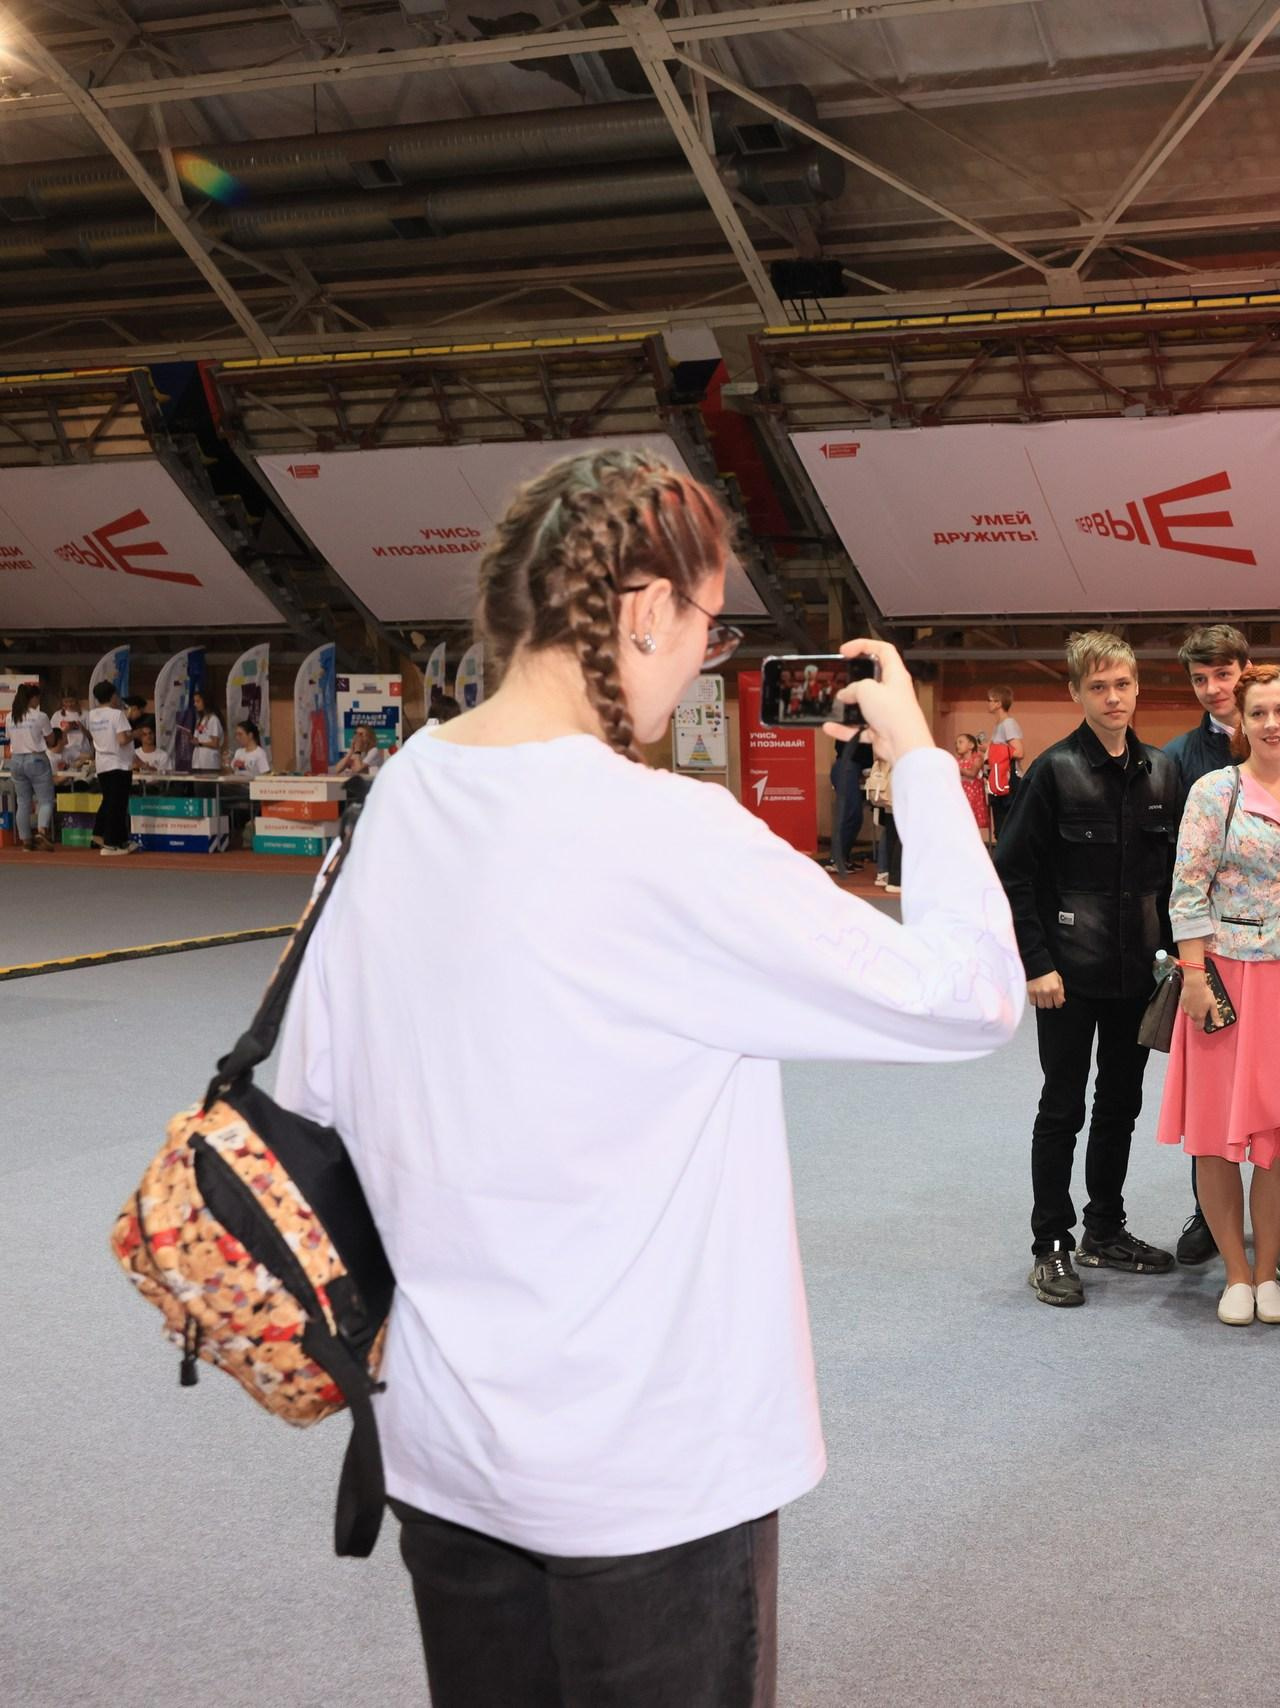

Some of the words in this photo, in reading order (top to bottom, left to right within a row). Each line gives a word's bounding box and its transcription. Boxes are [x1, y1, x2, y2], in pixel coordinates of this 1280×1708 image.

[971, 510, 1031, 526] УМЕЙ
[420, 527, 480, 540] УЧИСЬ
[933, 530, 1039, 545] ДРУЖИТЬ!
[372, 547, 387, 557] И
[757, 739, 805, 747] ПОЗНАВАЙ!
